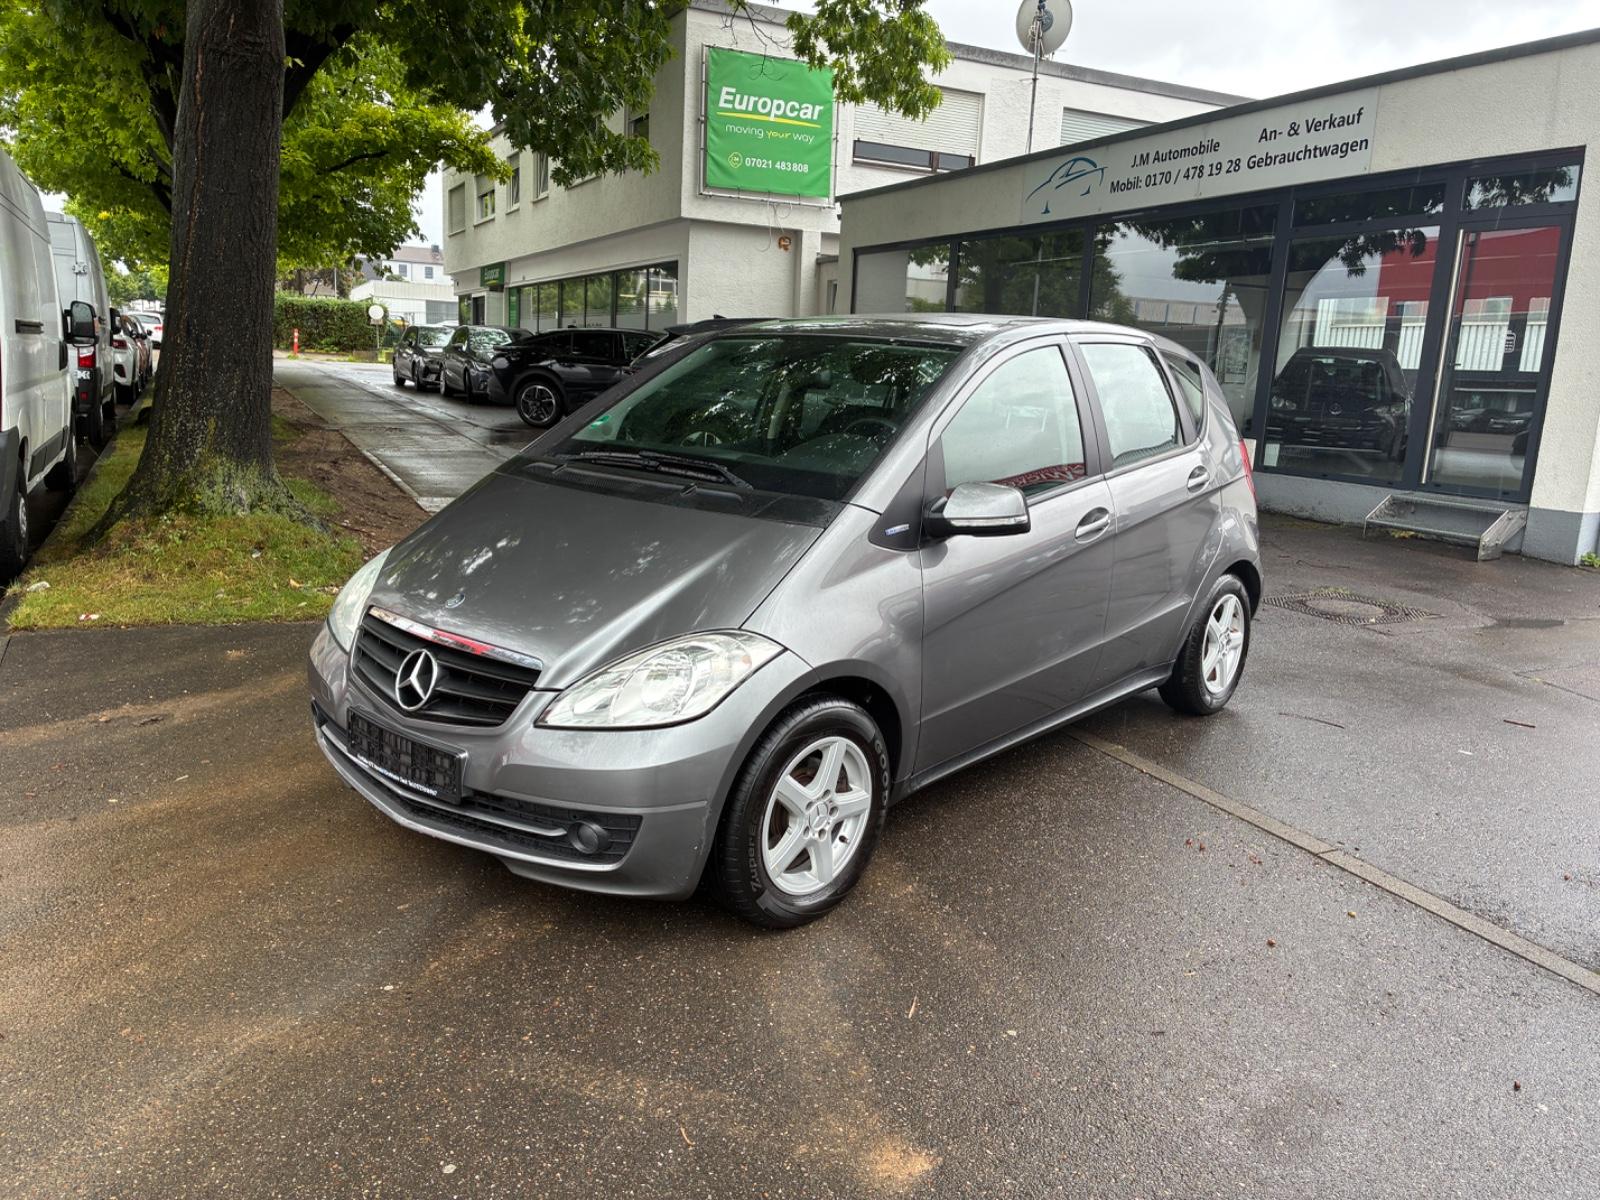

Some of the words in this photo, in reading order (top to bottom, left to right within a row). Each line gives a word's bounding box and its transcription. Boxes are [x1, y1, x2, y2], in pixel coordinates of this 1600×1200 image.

[718, 86, 824, 121] Europcar
[725, 124, 764, 139] moving
[766, 130, 792, 140] your
[792, 132, 815, 145] way
[1258, 127, 1283, 143] An-
[1287, 121, 1301, 137] &
[1305, 106, 1364, 134] Verkauf
[745, 157, 773, 169] 07021
[775, 161, 809, 173] 483808
[1131, 152, 1150, 168] J.M
[1152, 138, 1220, 164] Automobile
[1247, 138, 1369, 170] Gebrauchtwagen
[1109, 175, 1142, 194] Mobil:
[1144, 170, 1172, 188] 0170
[1173, 168, 1182, 185] /
[1183, 164, 1205, 181] 478
[1207, 161, 1223, 178] 19
[1225, 157, 1241, 174] 28
